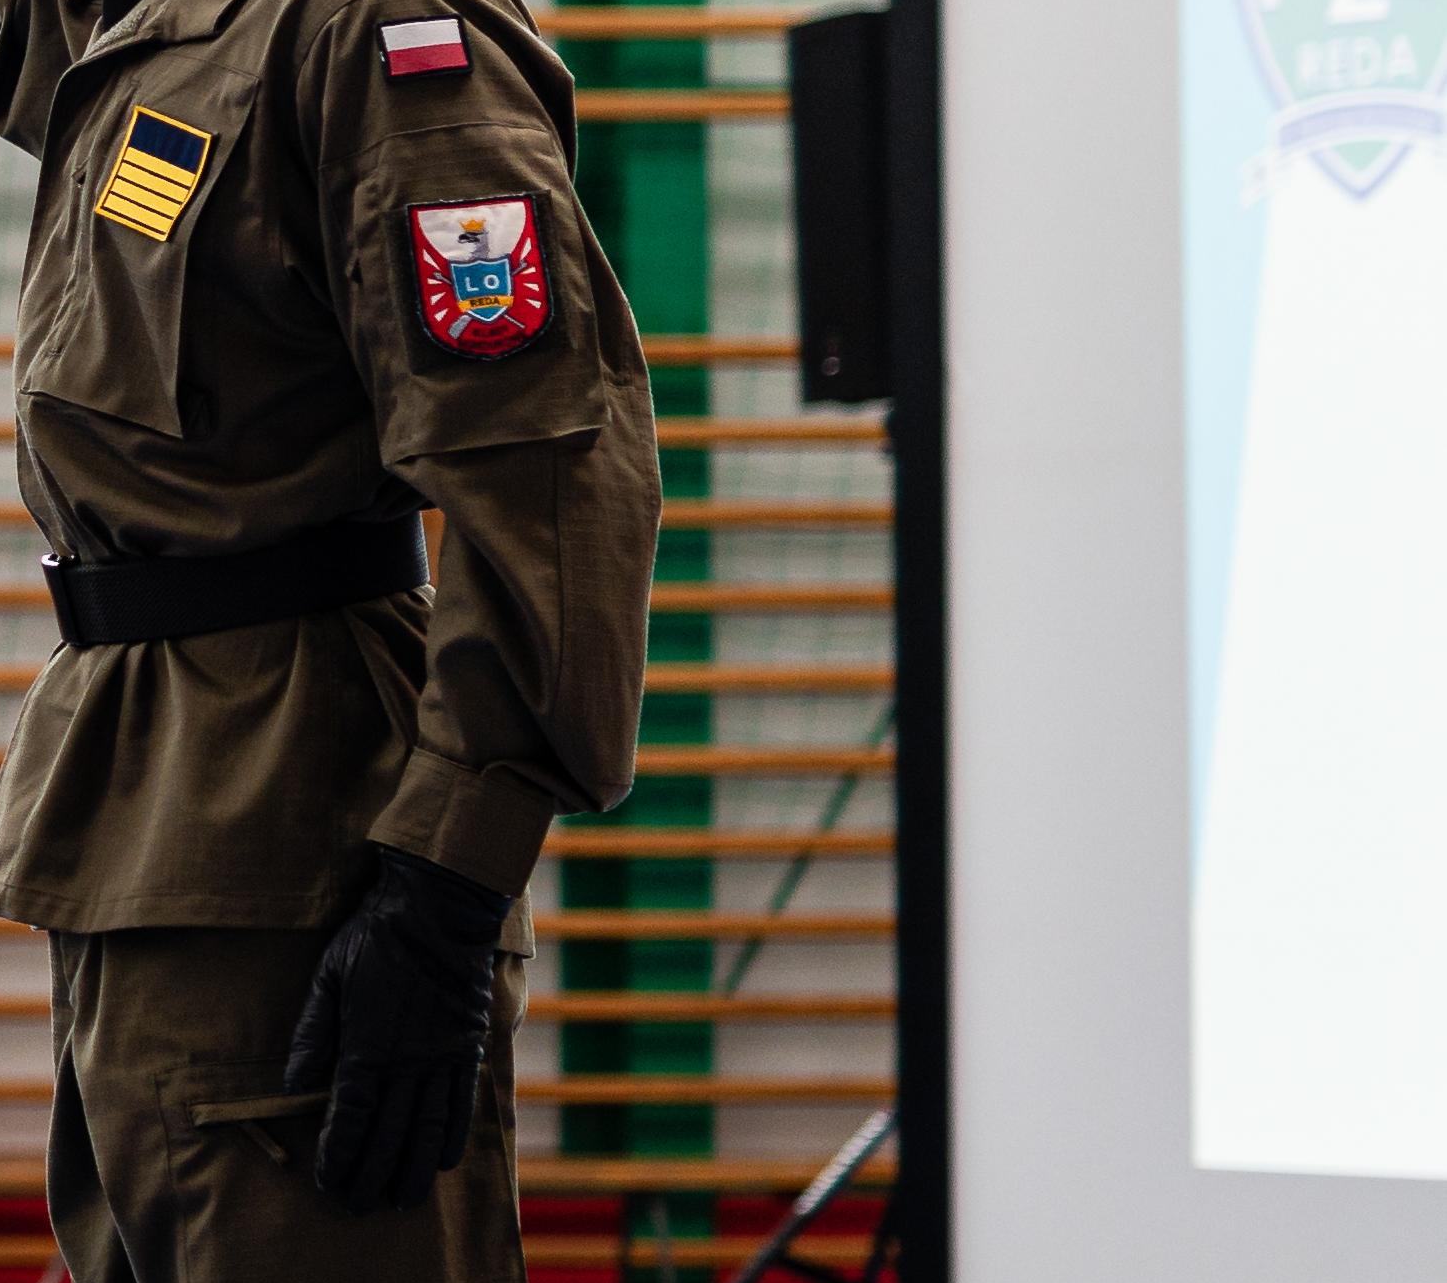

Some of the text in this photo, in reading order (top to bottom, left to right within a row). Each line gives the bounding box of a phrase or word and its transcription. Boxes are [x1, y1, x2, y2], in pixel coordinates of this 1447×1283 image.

[1298, 35, 1417, 90] REDA
[465, 274, 500, 291] LO
[470, 297, 500, 307] REDA
